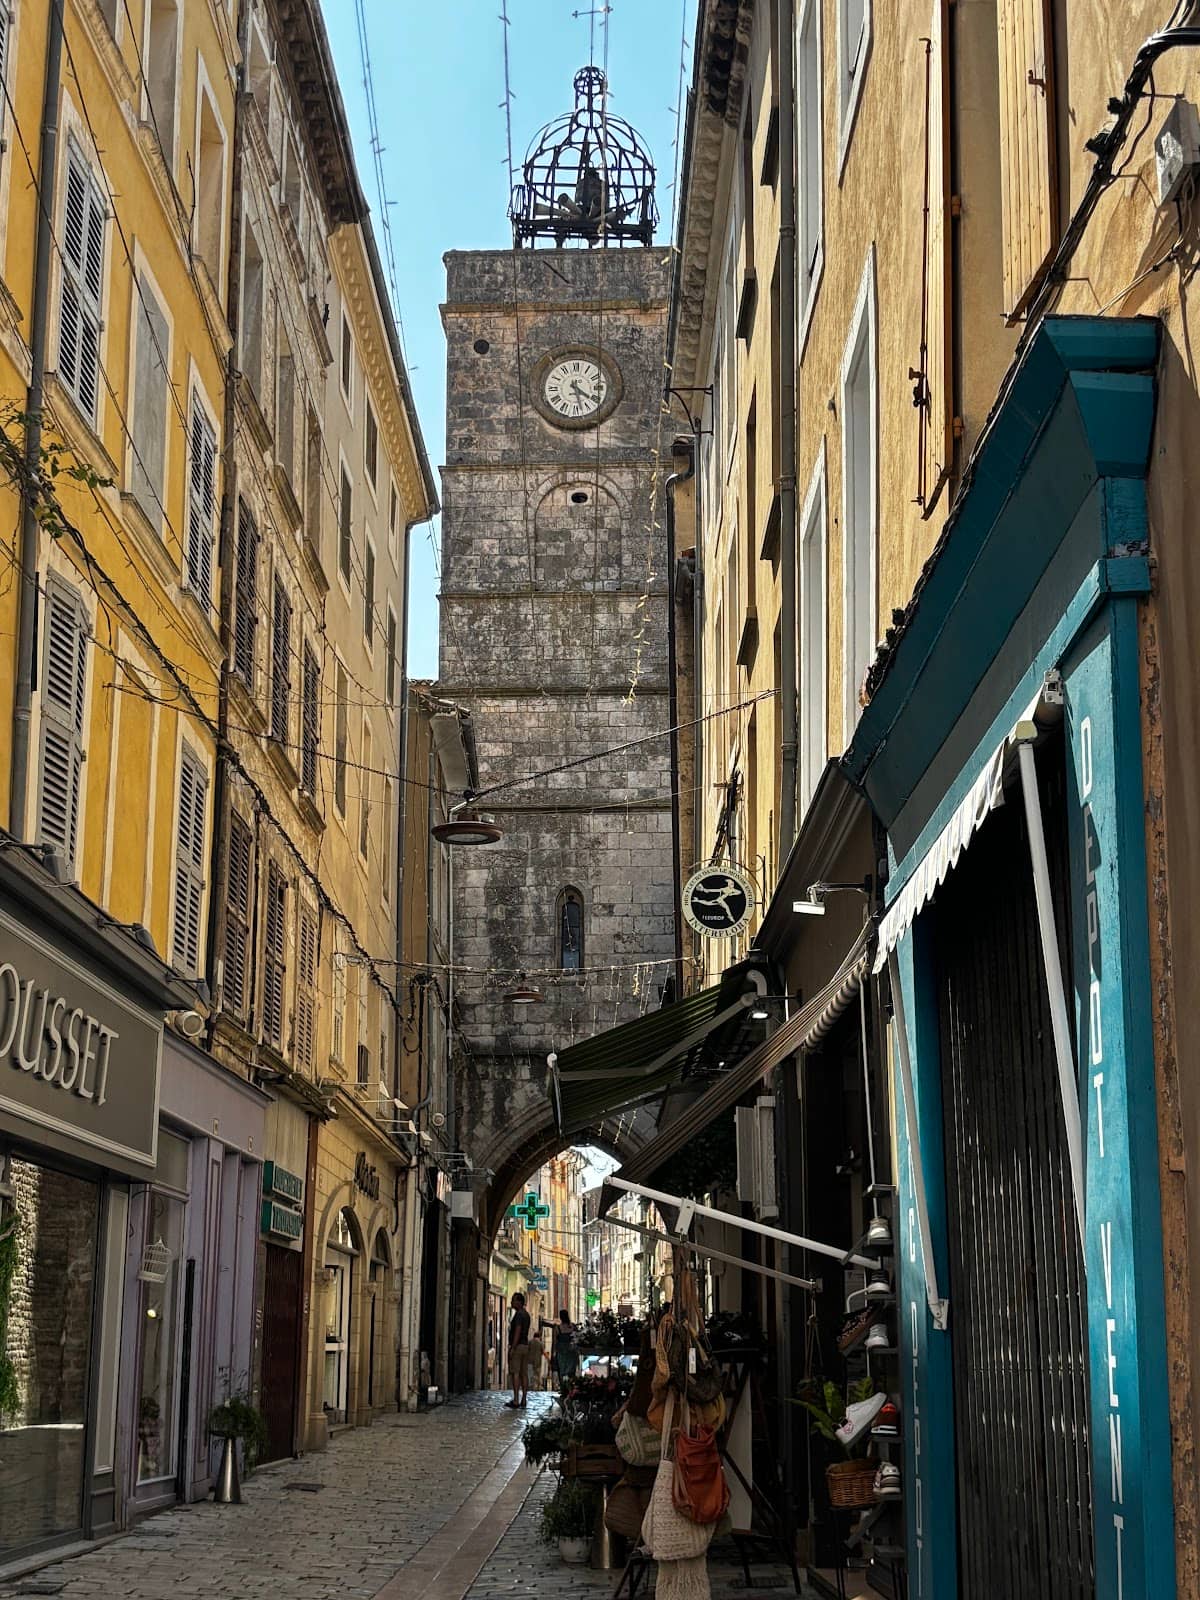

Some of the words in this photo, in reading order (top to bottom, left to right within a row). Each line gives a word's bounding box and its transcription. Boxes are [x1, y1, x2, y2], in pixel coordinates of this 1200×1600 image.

[688, 917, 749, 937] INTERFLORA
[1080, 716, 1105, 1157] DEPOT
[911, 1301, 923, 1598] DEPOT
